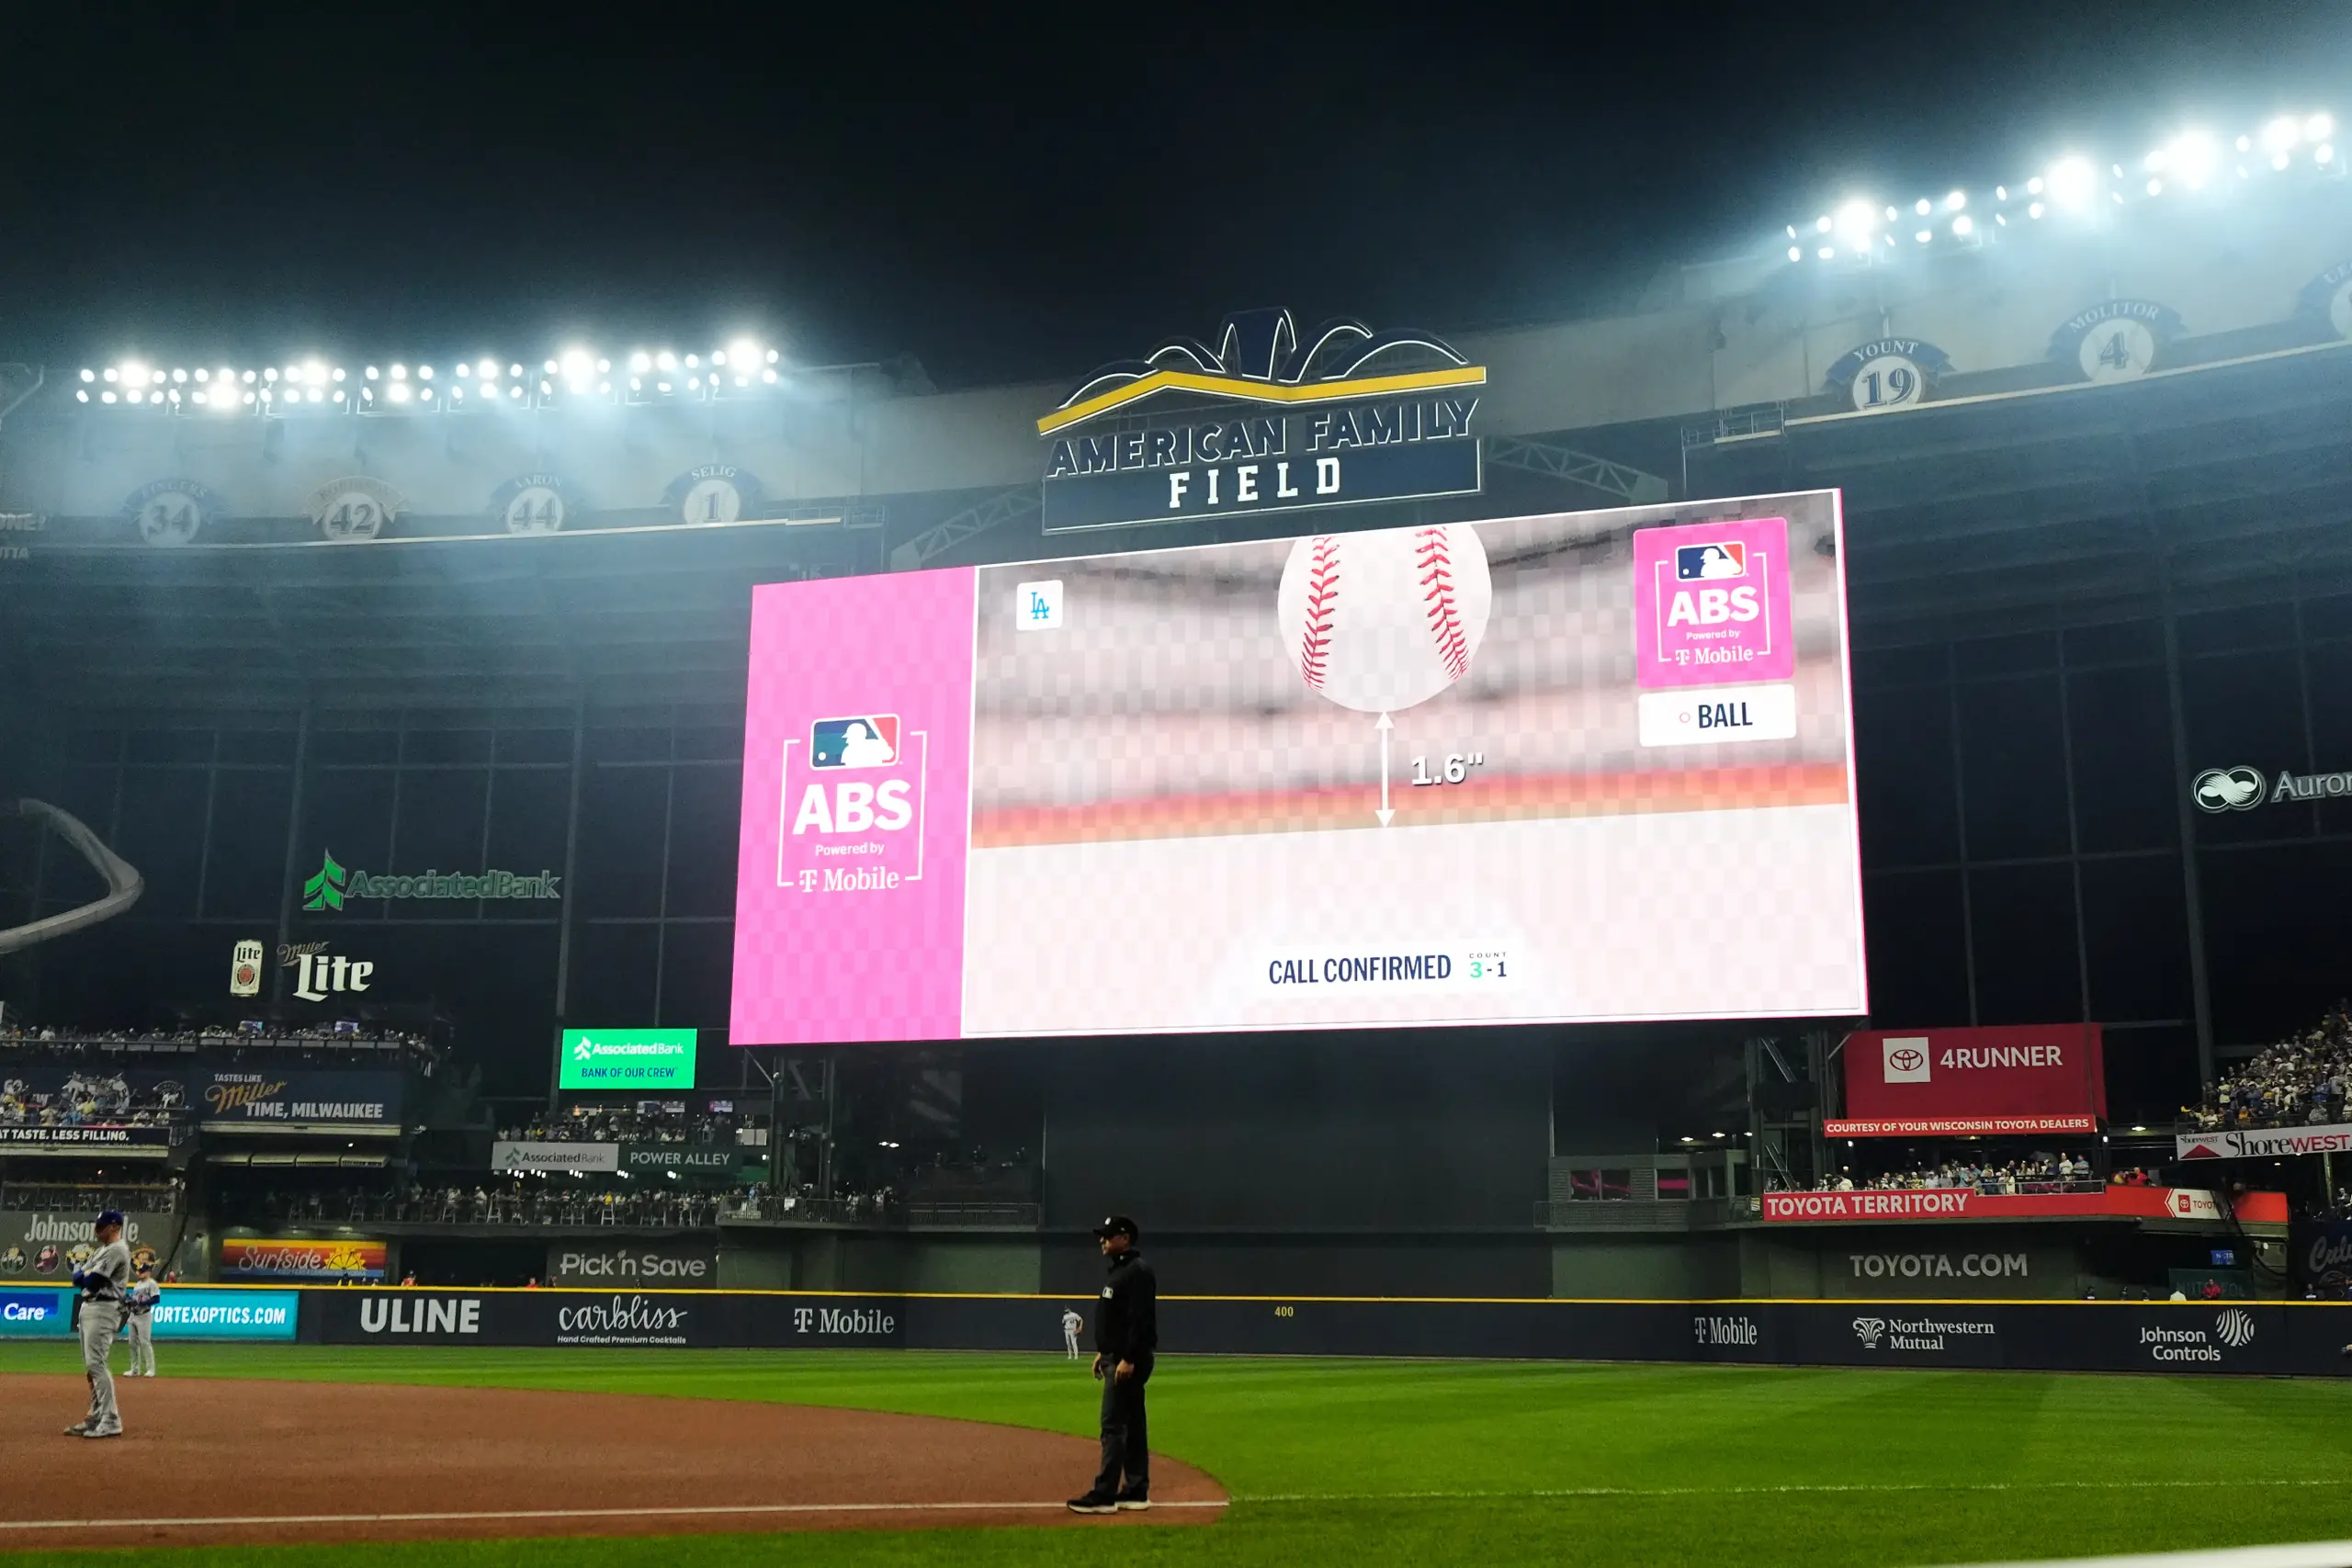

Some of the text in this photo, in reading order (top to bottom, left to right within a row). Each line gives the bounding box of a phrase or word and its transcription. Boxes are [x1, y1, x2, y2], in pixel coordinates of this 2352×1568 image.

[2069, 301, 2159, 333] MOLITOR
[1853, 340, 1918, 362] YOUNT
[2099, 331, 2130, 370] 4
[1861, 367, 1916, 407] 19
[1046, 398, 1480, 478] AMERICAN FAMILY
[515, 474, 562, 489] AARON
[691, 465, 737, 480] SELIG
[1169, 457, 1341, 508] FIELD
[331, 503, 376, 534] 42
[512, 497, 558, 528] 44
[703, 491, 721, 522] 1
[147, 504, 194, 535] 34
[1667, 586, 1760, 627] ABS
[1686, 628, 1741, 641] Powered by
[1698, 702, 1754, 729] BALL
[792, 779, 913, 835] ABS
[815, 842, 885, 856] Powered by
[236, 947, 261, 964] Lite
[277, 942, 331, 967] Miller
[1469, 951, 1507, 959] COUNT
[292, 953, 374, 1002] Lite
[1269, 954, 1452, 985] CALL CONFIRMED
[1939, 1045, 2063, 1070] 4RUNNER
[214, 1074, 263, 1083] TASTES LIKE
[582, 1067, 675, 1077] BANK OF OUR CREW
[204, 1080, 288, 1114] Miller
[244, 1102, 383, 1119] TIME, MILWAUKEE
[12, 1129, 50, 1141] TASTE.
[51, 1130, 80, 1141] LESS
[82, 1130, 130, 1142] FILLING.
[1826, 1118, 2089, 1133] COURTESY OF YOUR WISCONSIN TOYOTA DEALERS
[630, 1152, 730, 1166] POWER ALLEY
[1767, 1193, 1969, 1216] TOYOTA TERRITORY
[239, 1245, 322, 1271] Surfside
[560, 1253, 615, 1276] Pick
[641, 1254, 707, 1277] Save
[1849, 1253, 2028, 1278] TOYOTA.COM
[4, 1303, 46, 1321] Care
[359, 1299, 481, 1333] ULINE
[559, 1294, 688, 1331] carbliss
[1274, 1306, 1295, 1317] 400
[1889, 1319, 1996, 1334] Northwestern
[2140, 1326, 2207, 1344] Johnson
[580, 1336, 610, 1344] Crafted
[611, 1336, 648, 1344] Premium
[1890, 1335, 1944, 1350] Mutual
[2153, 1345, 2222, 1361] Controls
